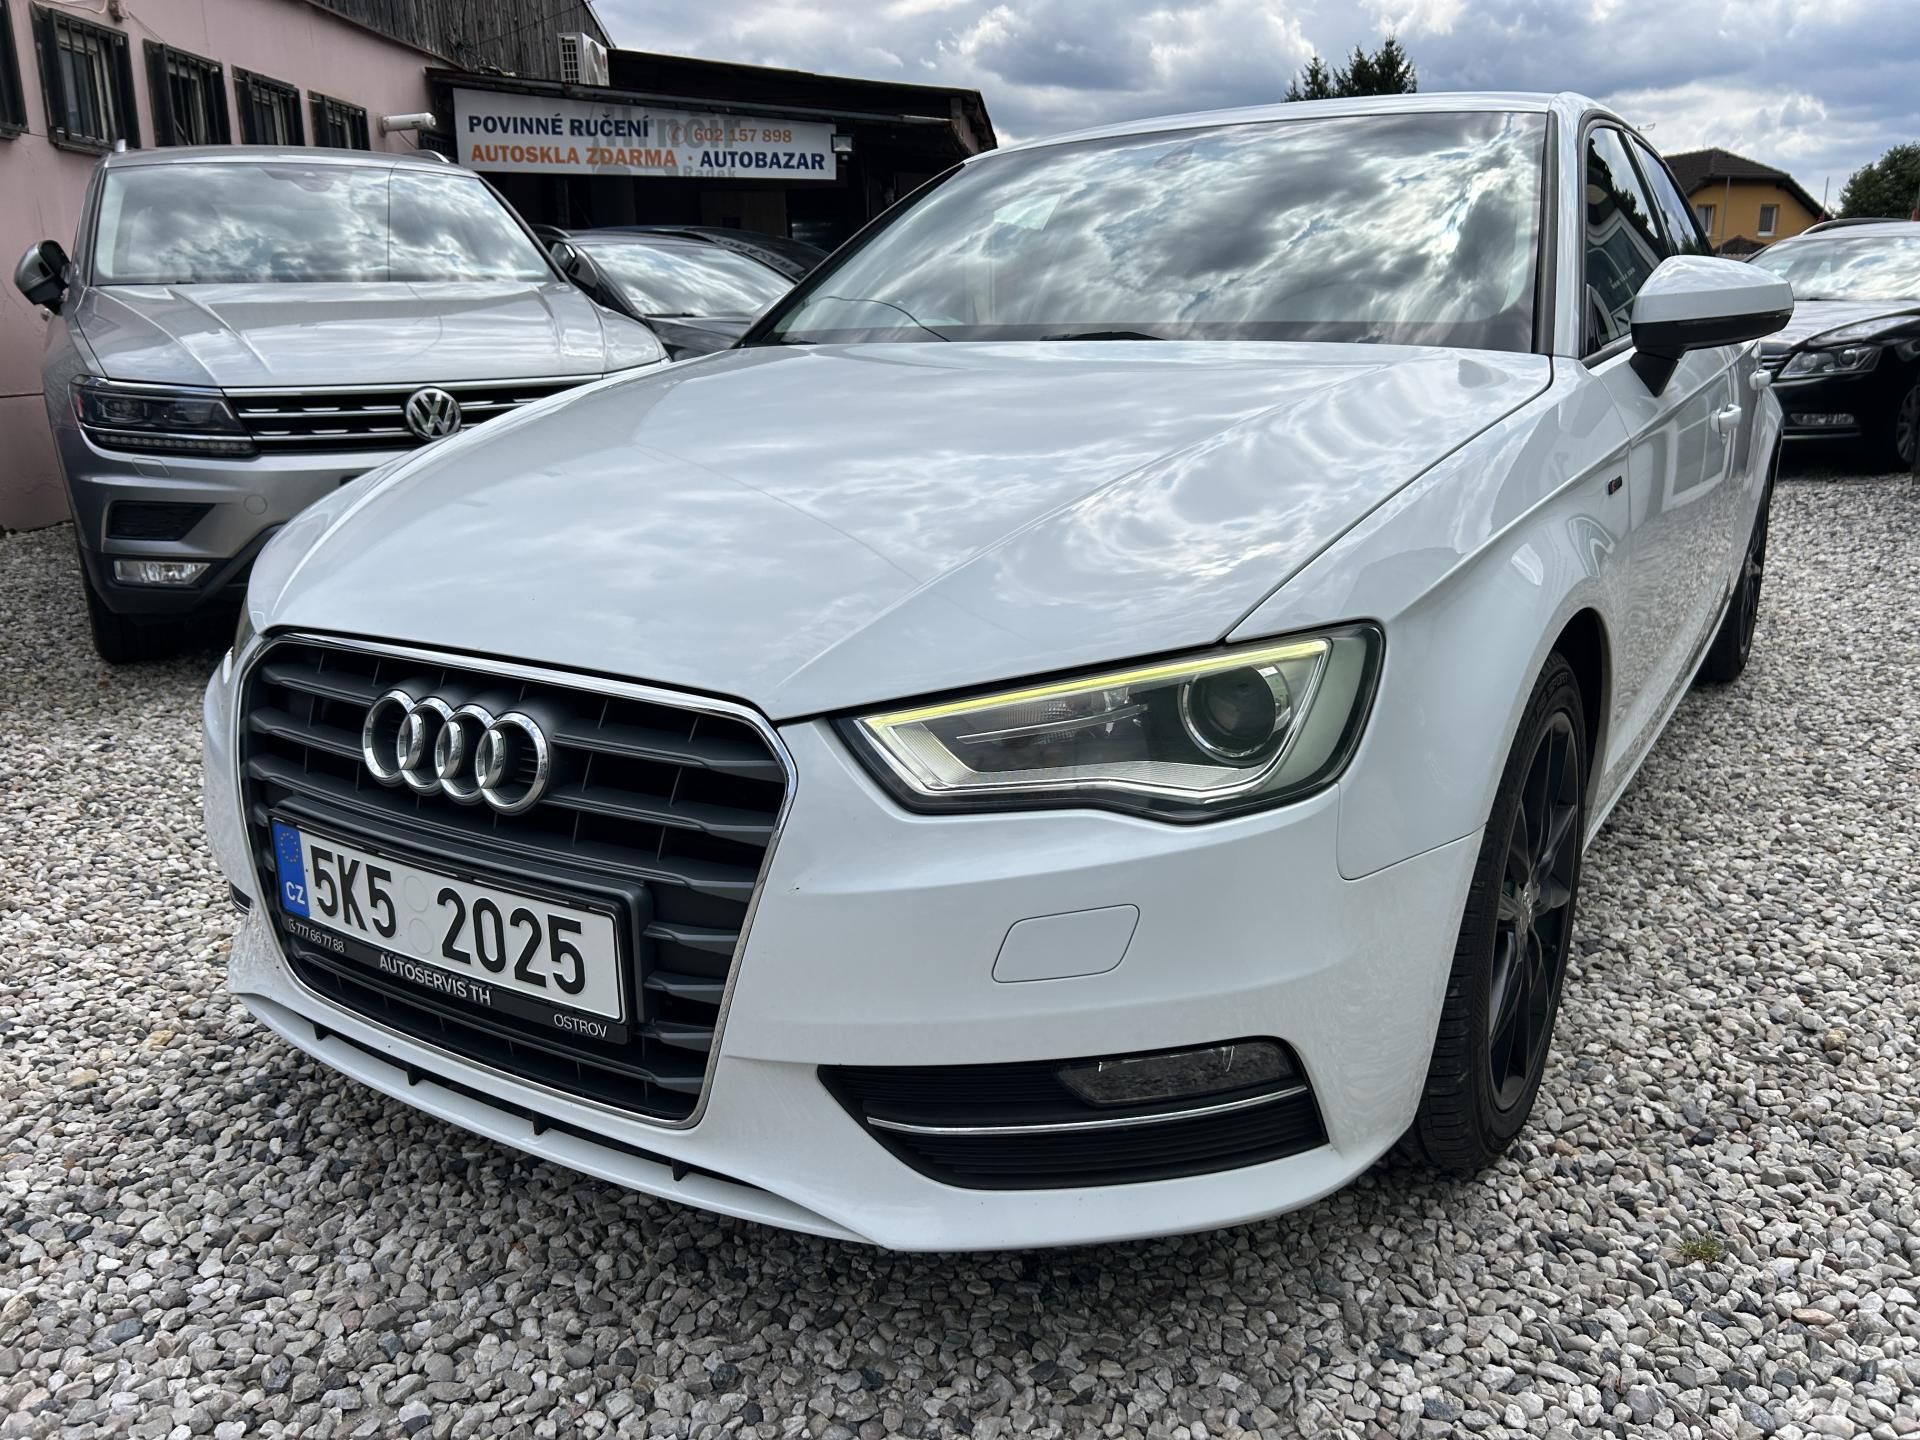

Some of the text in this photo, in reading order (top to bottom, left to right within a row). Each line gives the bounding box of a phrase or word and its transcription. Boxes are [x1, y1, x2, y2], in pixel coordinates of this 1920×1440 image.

[468, 113, 649, 137] POVINNÉ RUČENÍ
[694, 127, 793, 143] 602 157 898
[471, 144, 825, 170] AUTOSKLA ZDARMA AUTOBAZAR
[285, 880, 306, 905] CZ
[310, 845, 586, 995] 5K5 2025
[296, 922, 309, 937] 777
[322, 934, 332, 948] 77
[379, 953, 491, 1006] AUTOSERVIS TH
[553, 1013, 607, 1039] OSTROV
